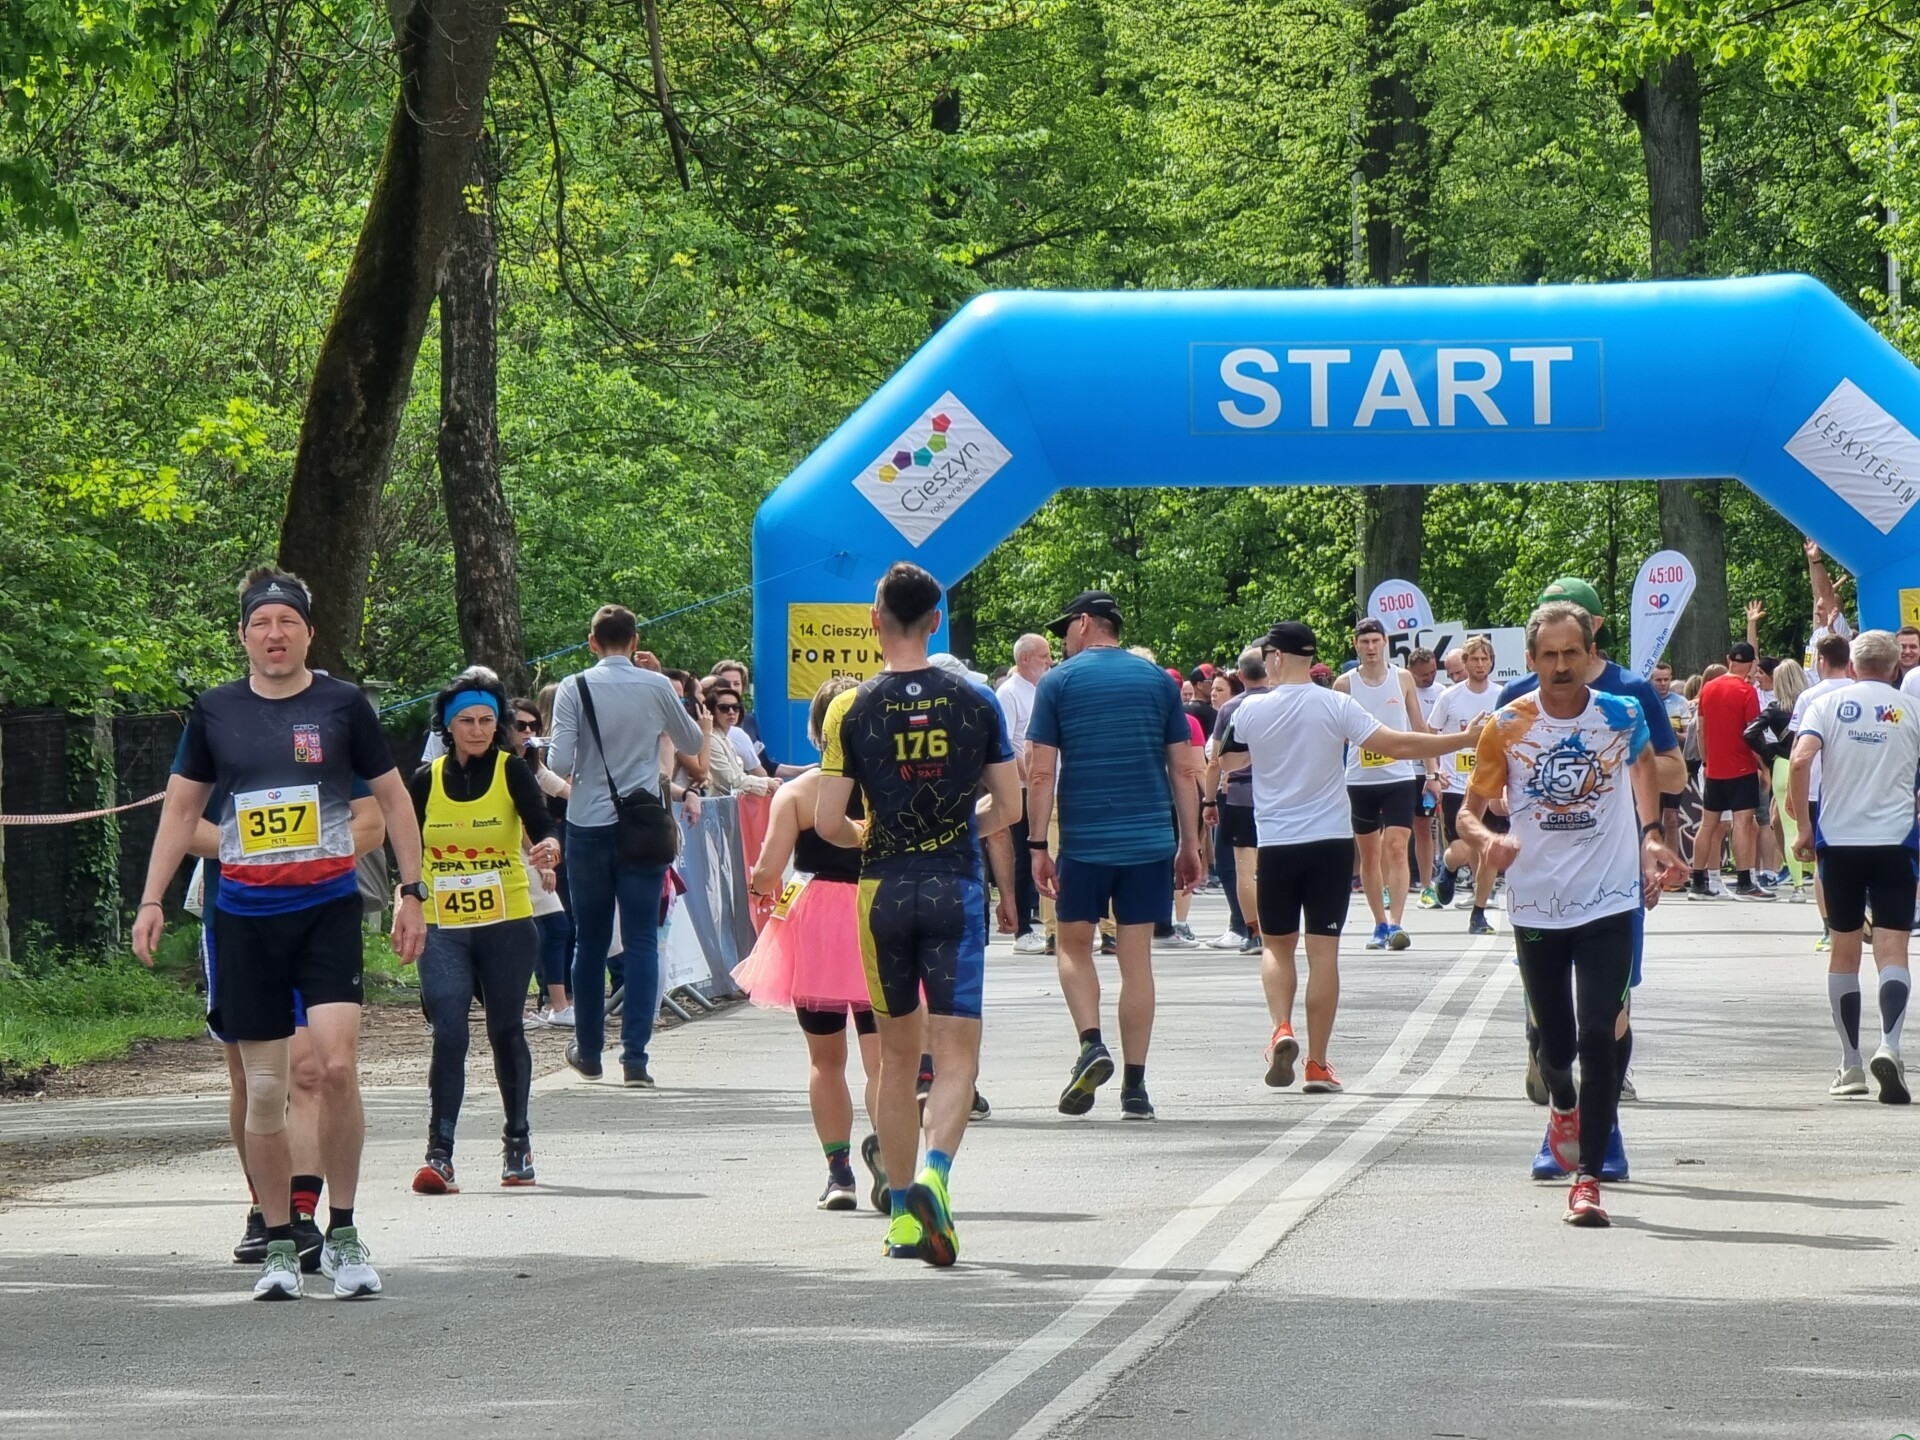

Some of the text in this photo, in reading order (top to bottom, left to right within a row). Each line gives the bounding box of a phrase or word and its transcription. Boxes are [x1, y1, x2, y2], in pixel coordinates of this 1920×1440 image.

[1217, 346, 1573, 428] START
[901, 441, 980, 512] Cieszyn
[1648, 566, 1683, 584] 45:00
[1379, 593, 1414, 613] 50:00
[799, 623, 818, 637] 14.
[1497, 667, 1521, 677] min.
[885, 697, 948, 712] HUBA
[894, 728, 949, 761] 176
[917, 768, 943, 778] RACE
[1551, 757, 1590, 797] 57
[248, 805, 307, 837] 357
[1548, 812, 1590, 824] CROSS
[430, 858, 512, 872] PEPA TEAM
[444, 888, 495, 914] 458
